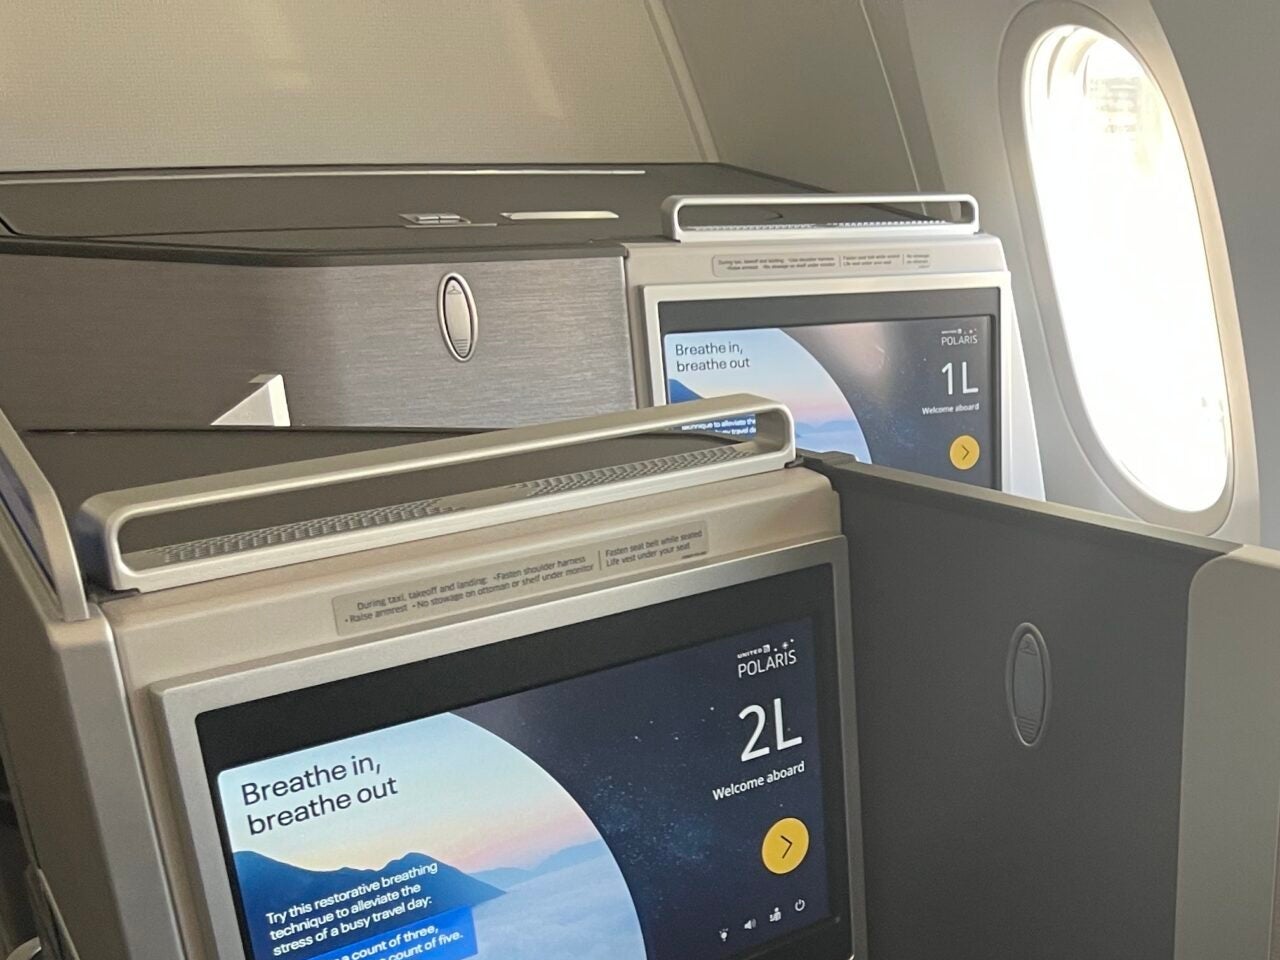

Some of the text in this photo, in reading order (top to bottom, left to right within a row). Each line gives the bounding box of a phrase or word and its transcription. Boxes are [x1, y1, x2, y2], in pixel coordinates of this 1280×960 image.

[675, 341, 743, 356] Breathe in,
[941, 335, 977, 346] POLARIS
[677, 358, 750, 372] breathe out
[942, 361, 979, 395] 1L
[922, 403, 980, 415] Welcome aboard
[605, 546, 628, 557] Fasten
[630, 543, 644, 552] seat
[606, 556, 620, 567] Life
[621, 554, 636, 564] vest
[637, 550, 657, 560] under
[659, 546, 675, 557] your
[676, 542, 690, 552] seat
[357, 597, 386, 611] During
[440, 583, 455, 593] and
[523, 561, 555, 575] shoulder
[558, 556, 586, 568] harness
[417, 600, 430, 609] No
[465, 590, 476, 598] on
[511, 580, 519, 588] or
[541, 570, 563, 581] under
[737, 649, 797, 678] POLARIS
[738, 698, 802, 762] 2L
[241, 755, 381, 806] Breathe in,
[712, 761, 805, 800] Welcome aboard
[247, 777, 398, 835] breathe out
[266, 862, 438, 925] Try this restorative breathing
[270, 884, 421, 941] technique to alleviate the
[273, 896, 432, 956] stress of a busy travel day:
[351, 941, 387, 960] count
[388, 935, 401, 948] of
[403, 924, 438, 942] three,
[425, 936, 437, 950] of
[439, 931, 464, 946] five.
